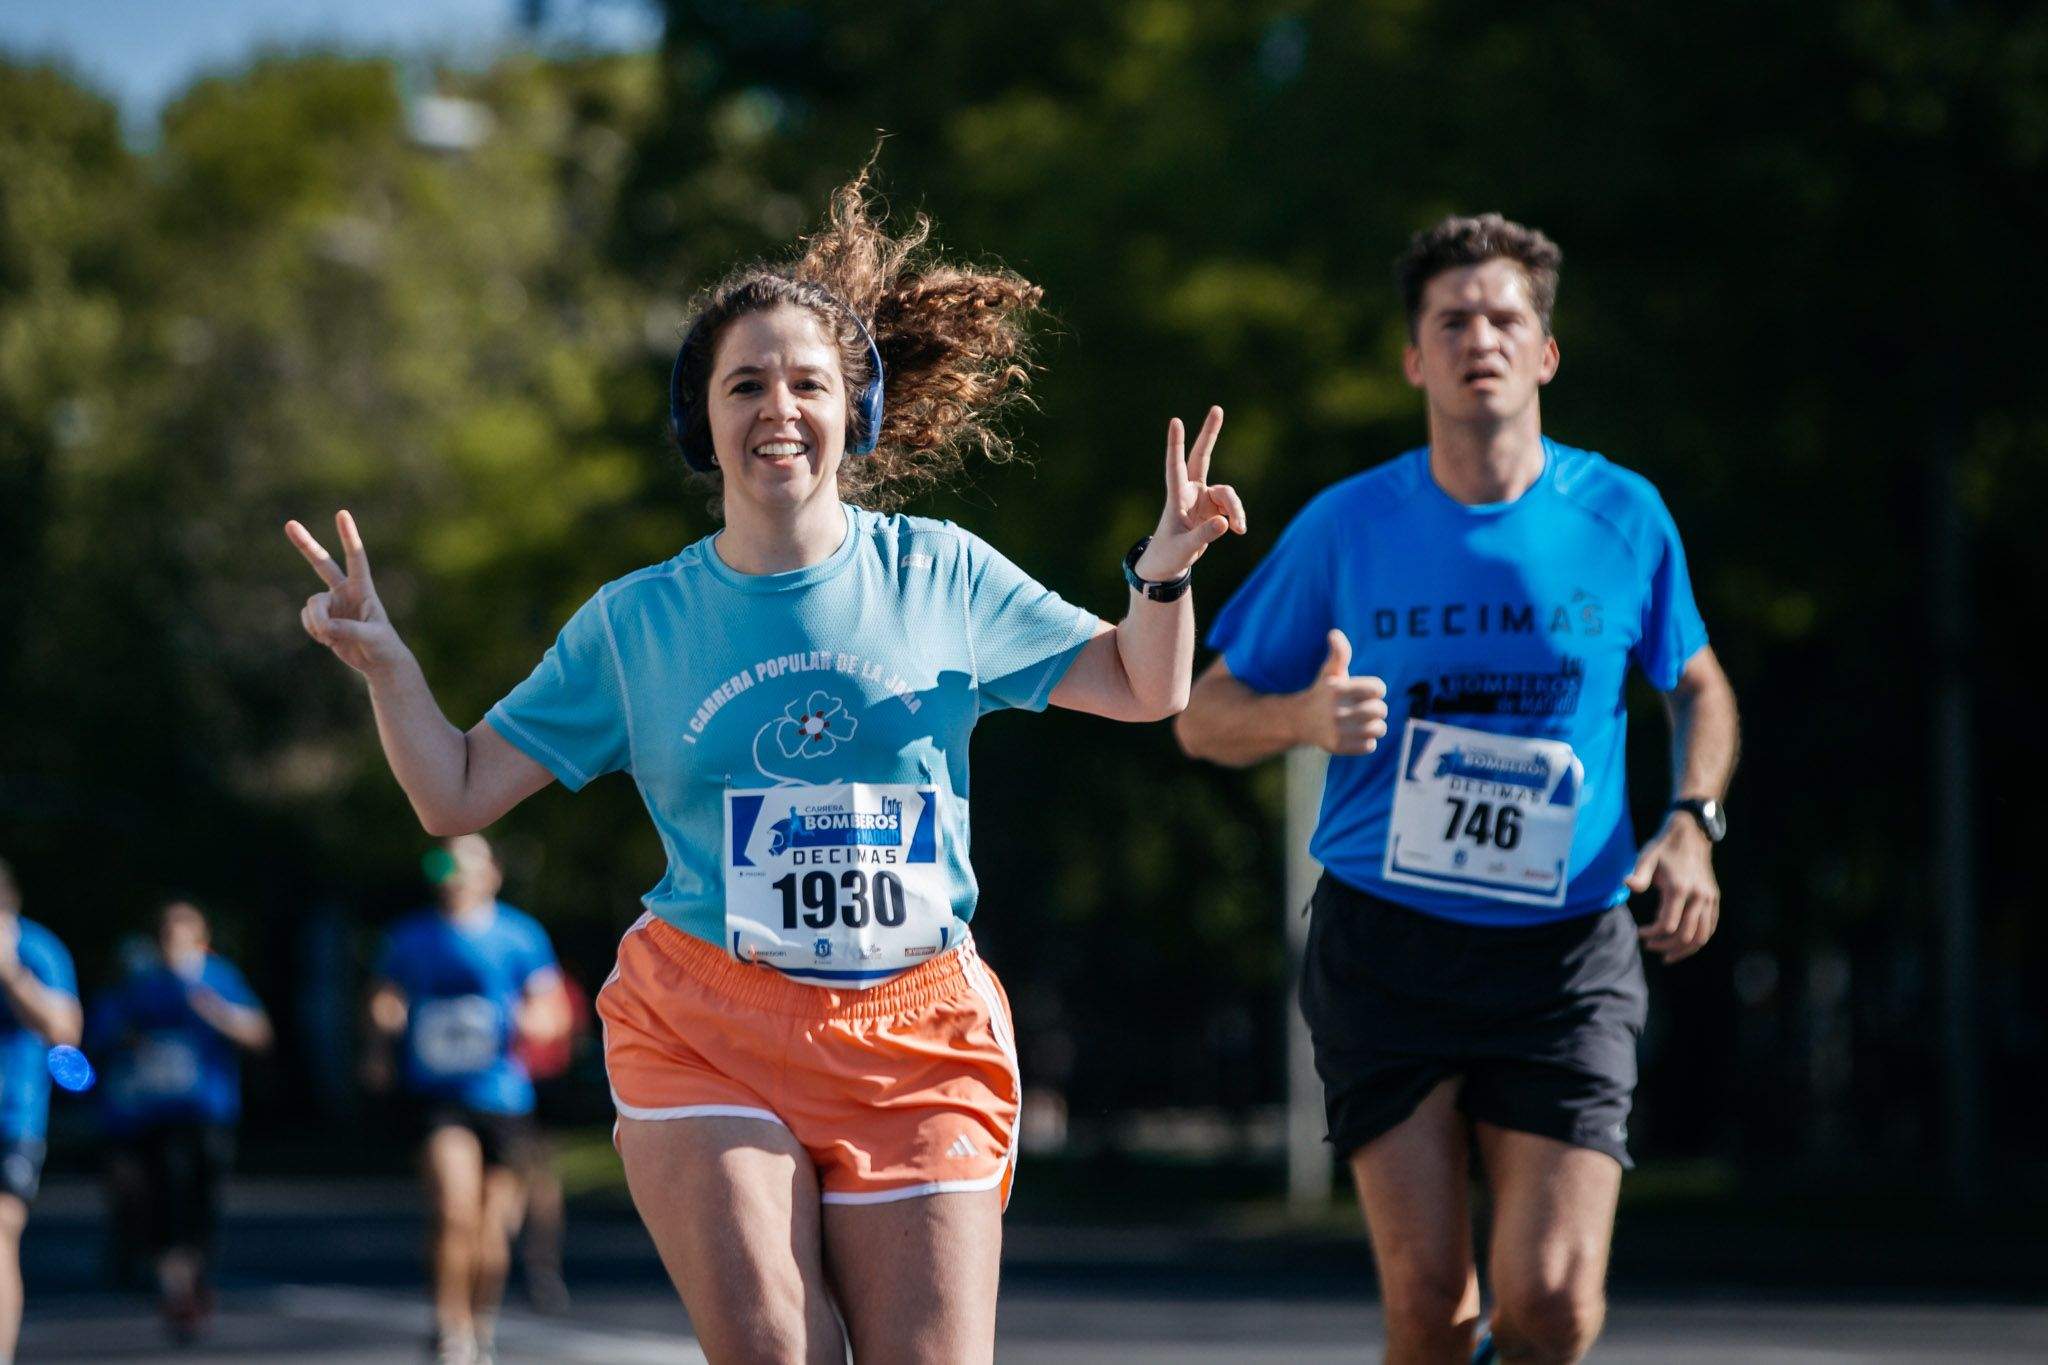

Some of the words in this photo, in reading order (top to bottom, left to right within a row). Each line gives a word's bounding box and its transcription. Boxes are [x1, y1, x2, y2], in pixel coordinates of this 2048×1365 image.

[1375, 604, 1602, 638] DECIMAS
[755, 651, 832, 683] POPULAR
[836, 652, 859, 673] DE
[862, 660, 884, 682] LA
[689, 670, 755, 733] CARRERA
[682, 733, 697, 745] I
[805, 804, 844, 813] CARRERA
[805, 813, 898, 831] BOMBEROS
[1443, 796, 1523, 850] 746
[793, 848, 897, 866] DECIMAS
[772, 870, 907, 930] 1930
